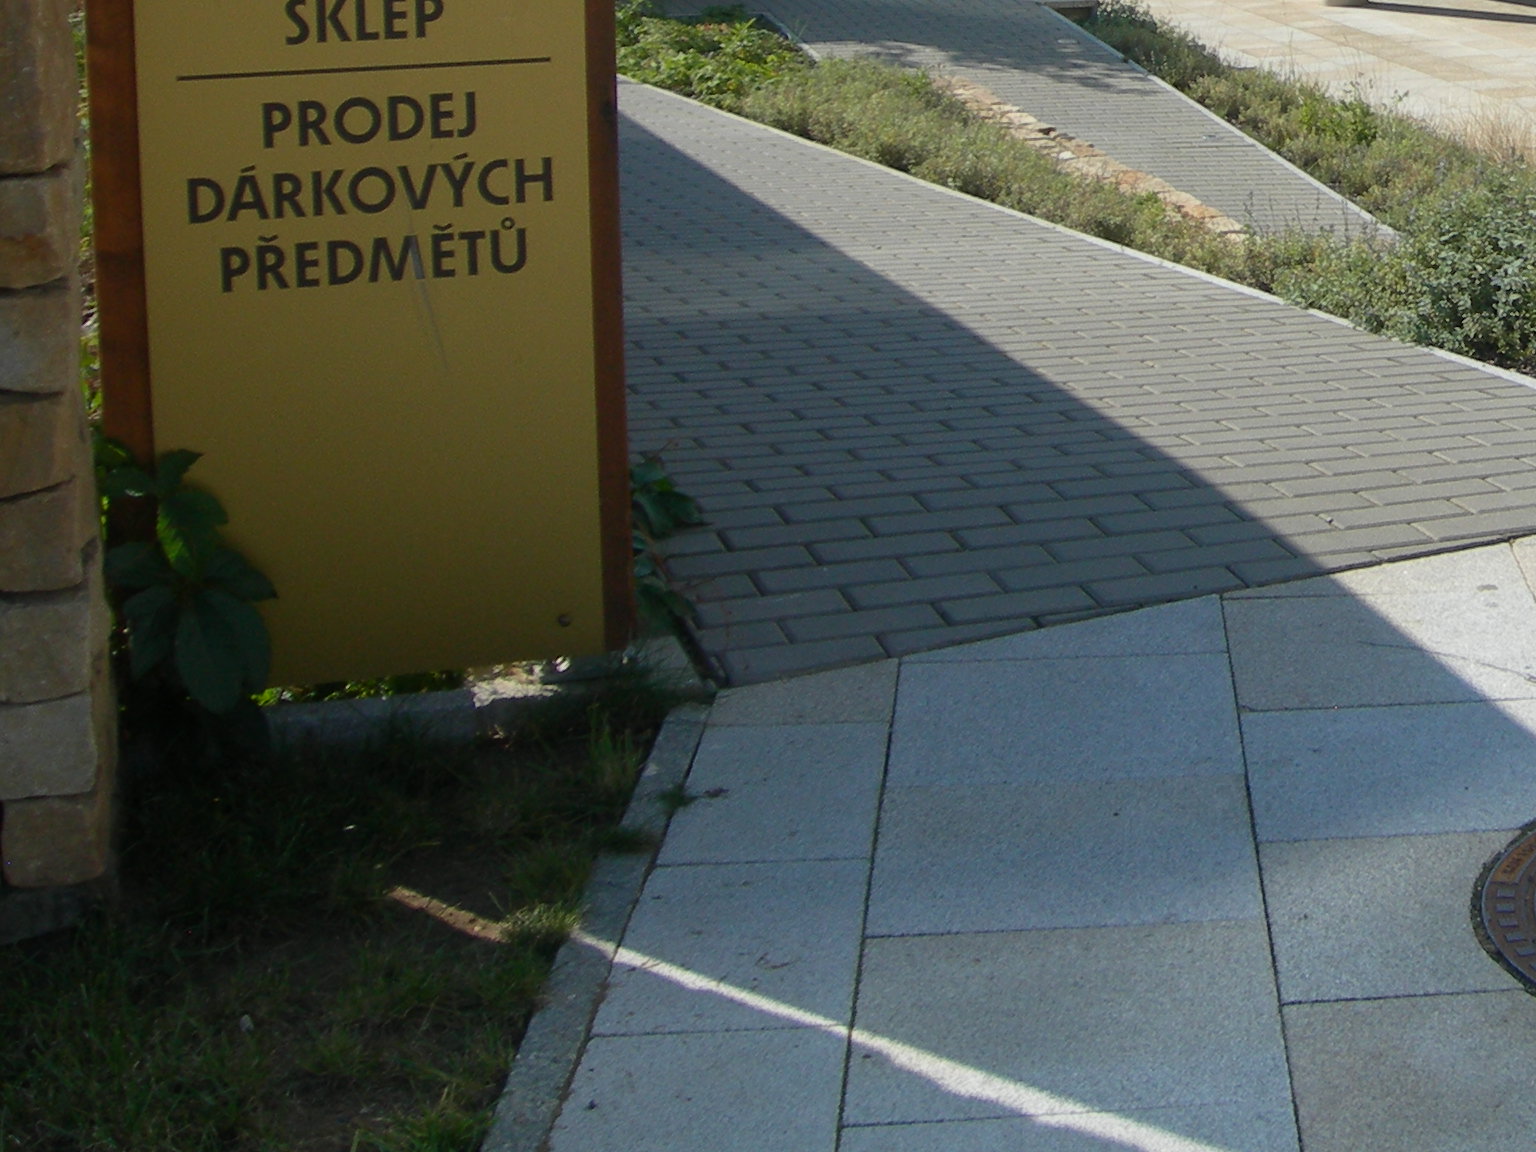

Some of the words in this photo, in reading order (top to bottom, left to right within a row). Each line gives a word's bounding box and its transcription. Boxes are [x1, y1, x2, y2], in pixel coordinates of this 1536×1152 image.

[262, 91, 477, 149] PRODEJ
[187, 153, 554, 225] DÁRKOVÝCH
[219, 216, 528, 294] PŘEDMĚTŮ
